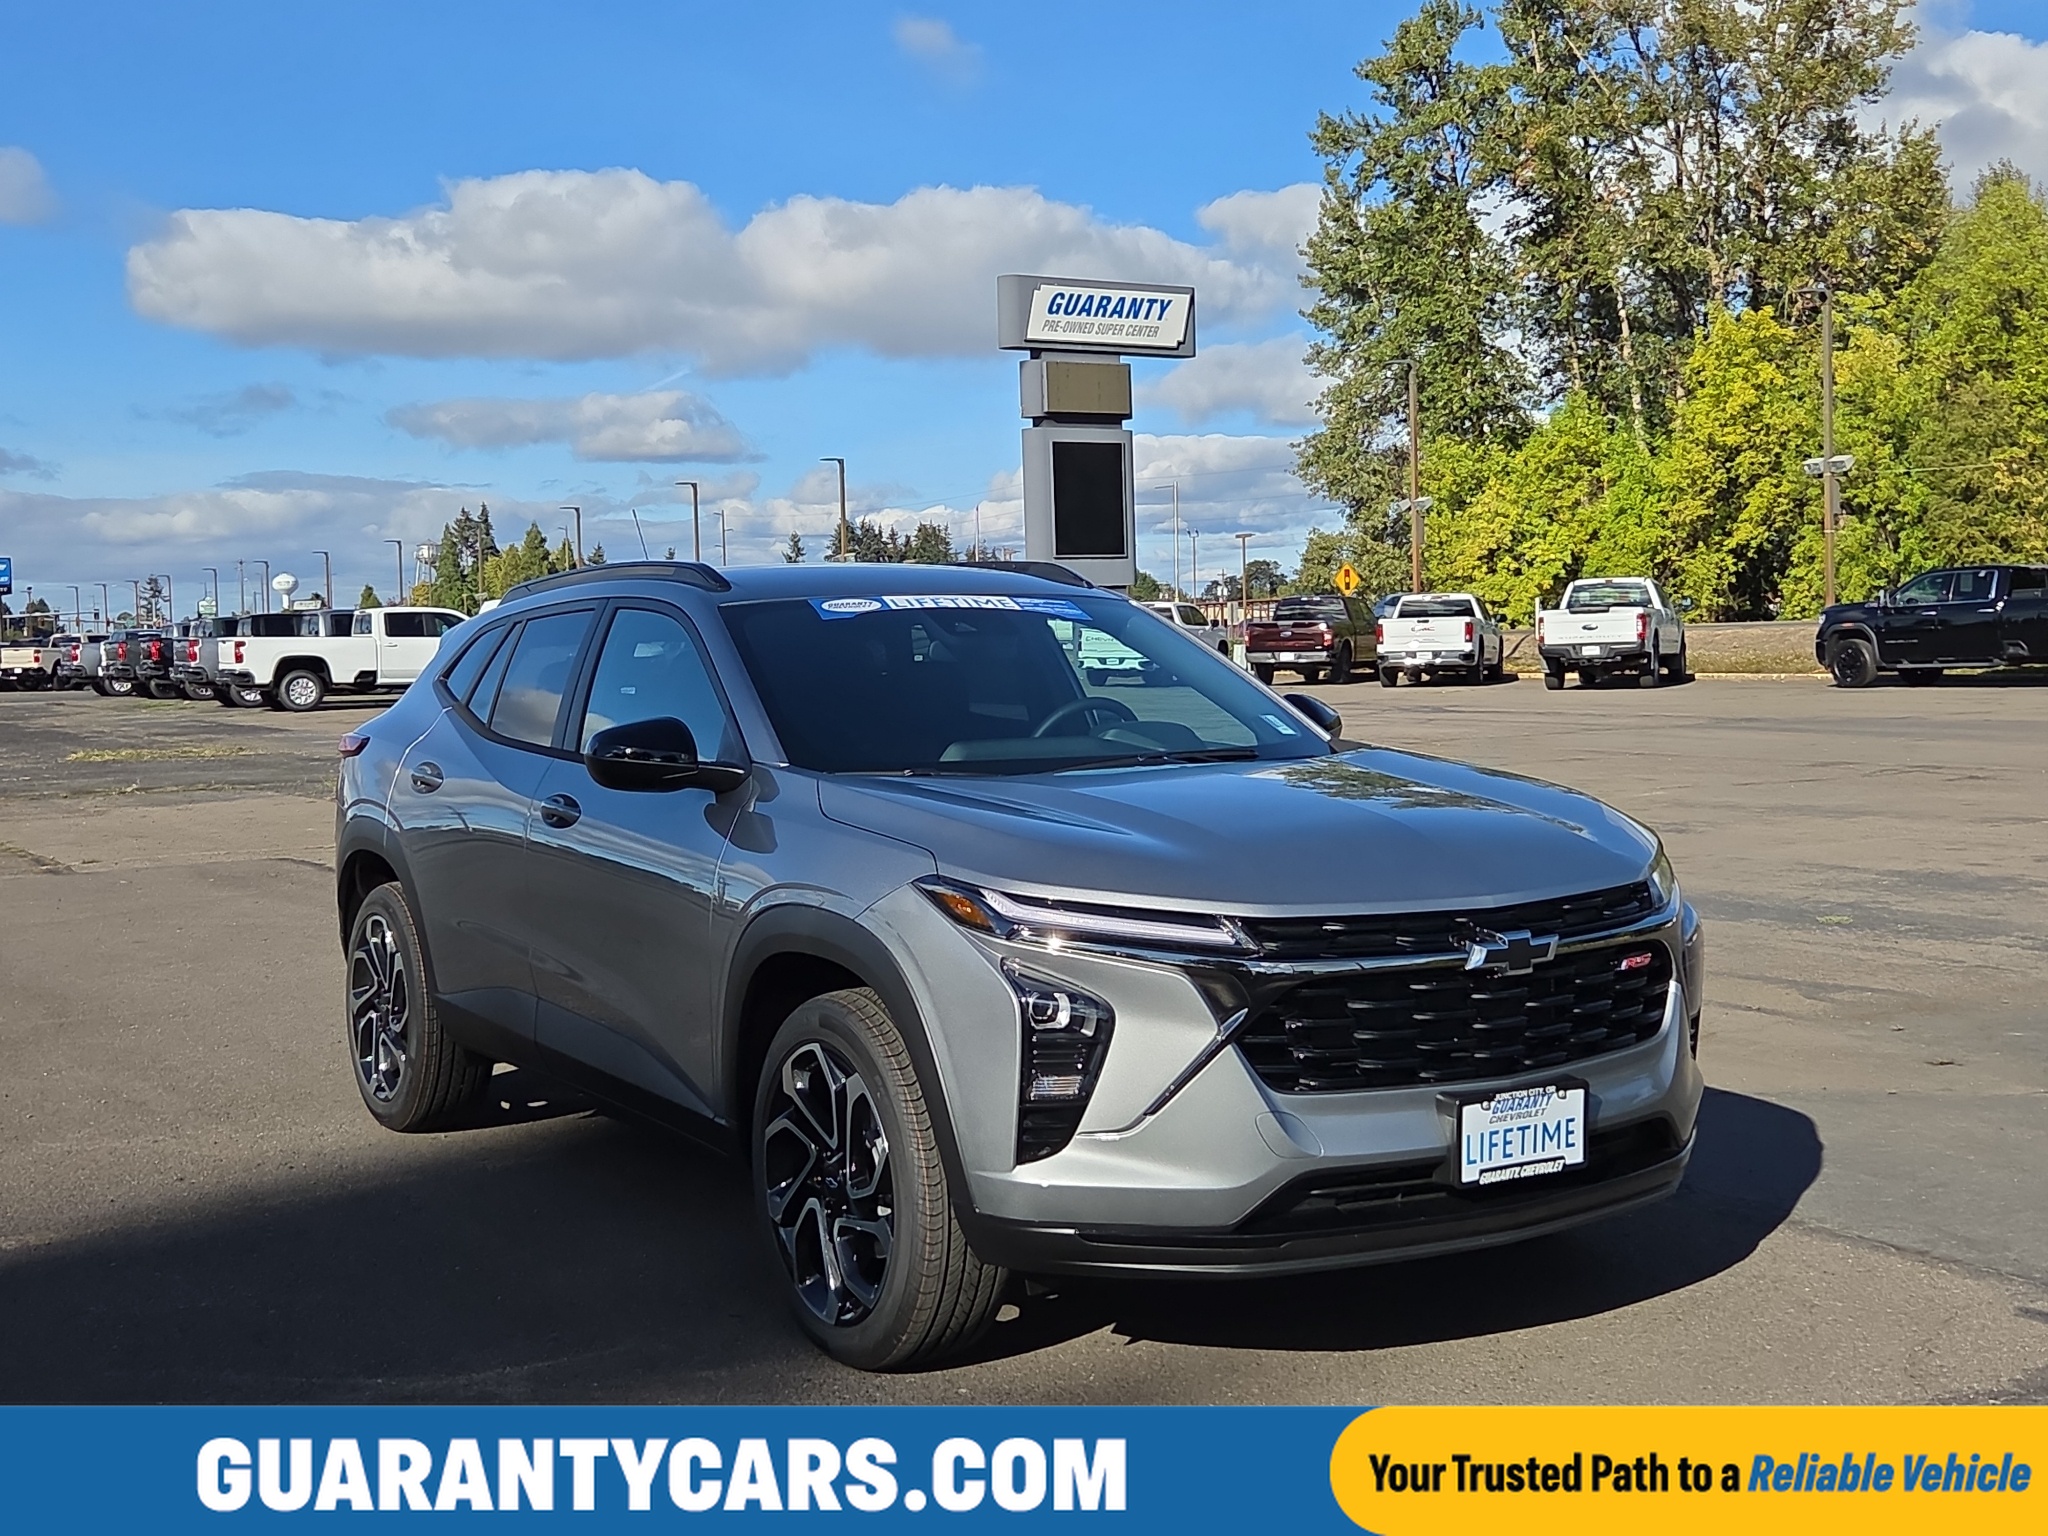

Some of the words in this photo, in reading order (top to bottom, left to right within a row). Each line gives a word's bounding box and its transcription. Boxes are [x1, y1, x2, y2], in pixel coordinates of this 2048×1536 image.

[1047, 292, 1173, 321] GUARANTY
[1042, 319, 1095, 335] PRE-OWNED
[1095, 322, 1124, 336] SUPER
[1125, 324, 1160, 338] CENTER
[889, 596, 1016, 609] LIFETIME
[1492, 1093, 1555, 1114] GUARANTY
[1489, 1108, 1547, 1124] CHEVROLET
[1466, 1118, 1576, 1165] LIFETIME
[1520, 1160, 1565, 1177] CHEVROLET
